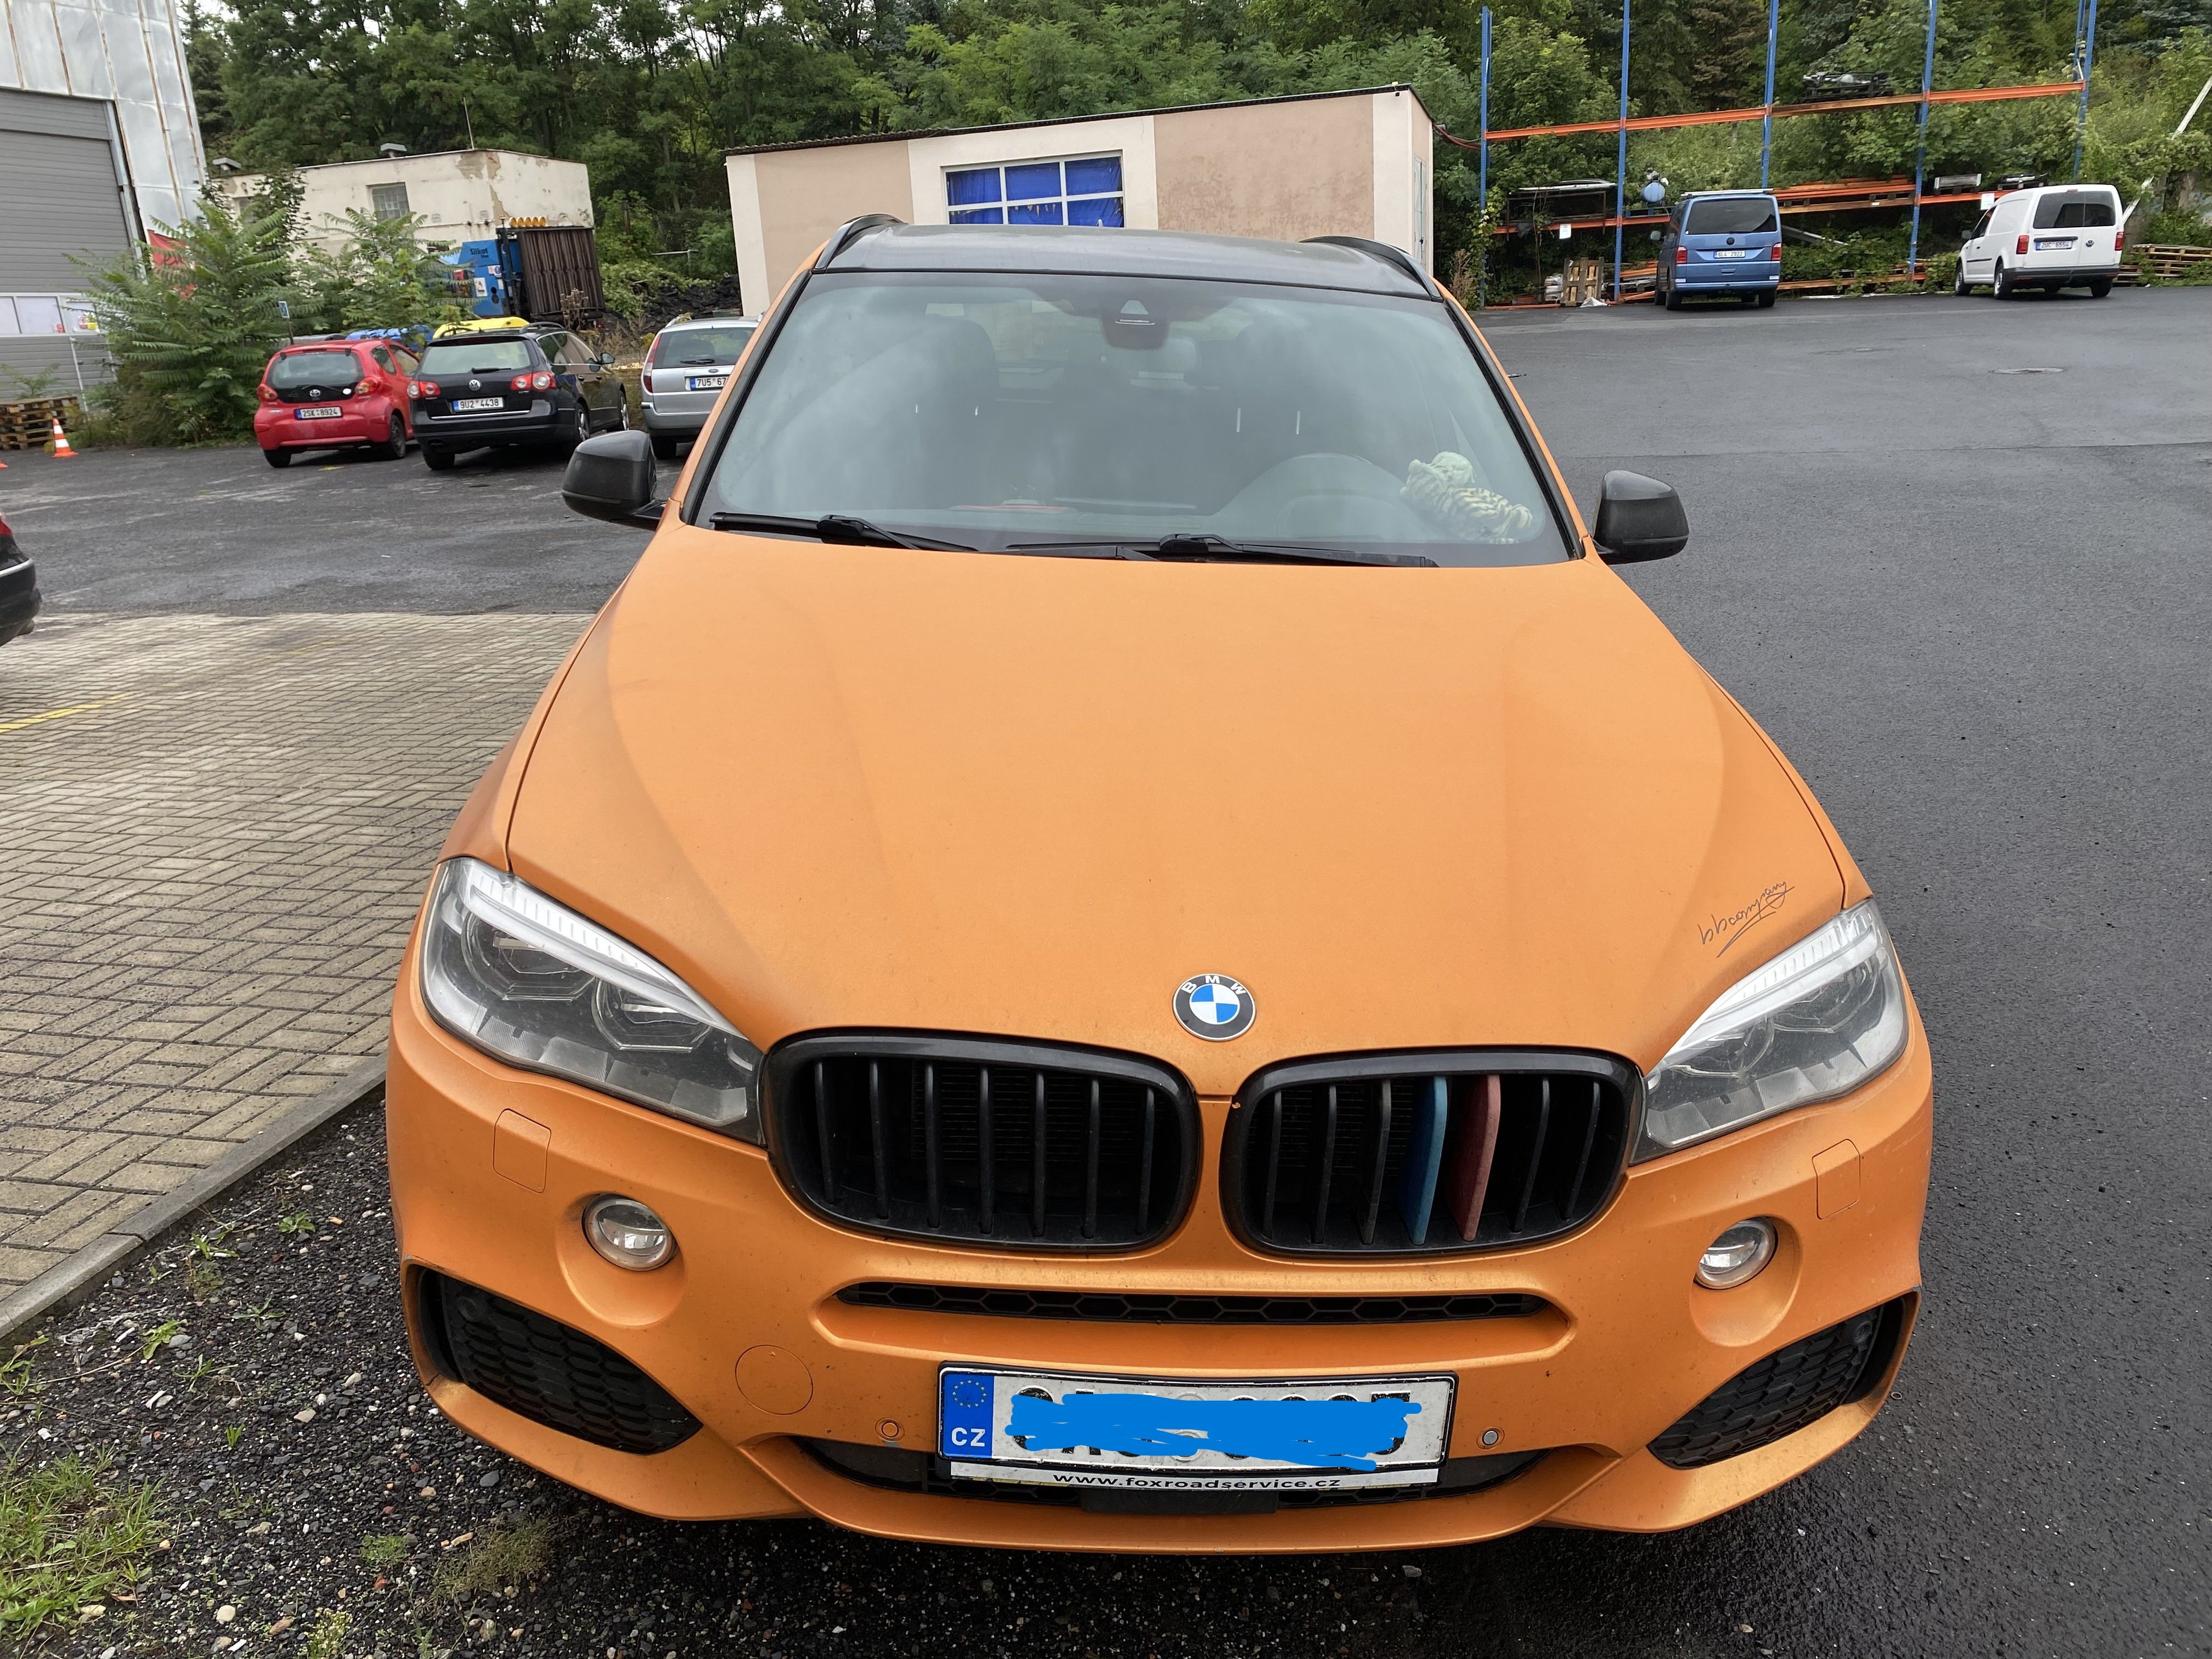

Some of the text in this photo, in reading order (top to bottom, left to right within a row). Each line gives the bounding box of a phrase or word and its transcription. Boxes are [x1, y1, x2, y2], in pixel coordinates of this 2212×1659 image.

[697, 377, 727, 387] 7U5 67
[460, 398, 499, 409] 9U2 4438
[1181, 975, 1247, 995] BMW
[951, 1427, 985, 1447] CZ
[1053, 1474, 1341, 1488] www.foxroadservice.cz
